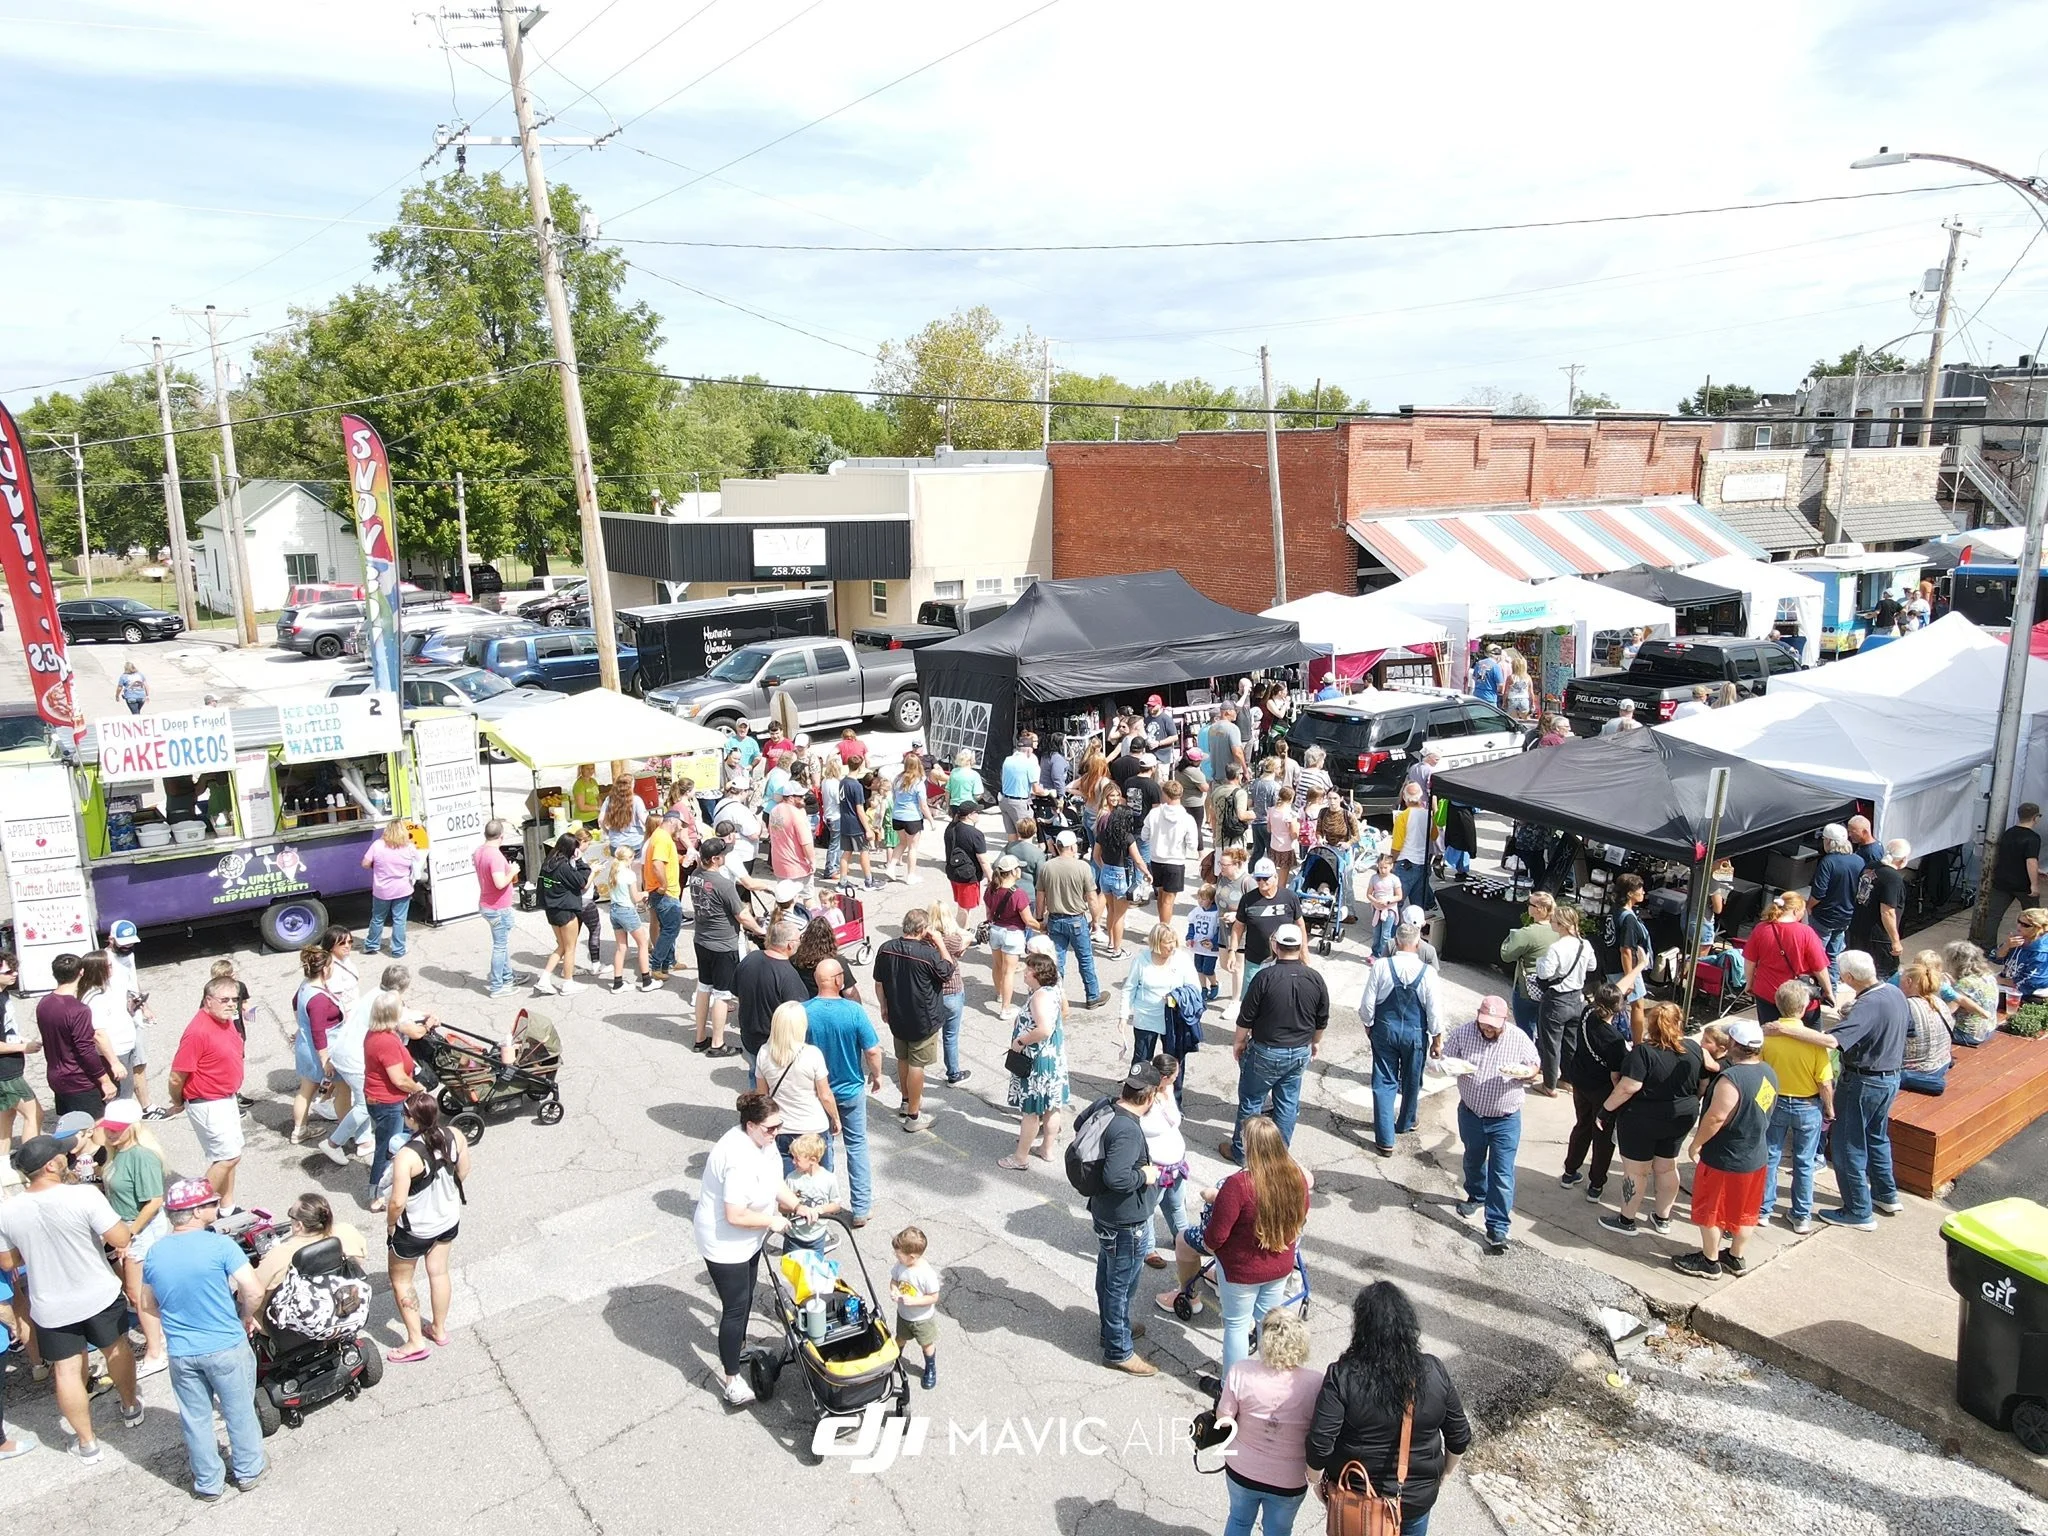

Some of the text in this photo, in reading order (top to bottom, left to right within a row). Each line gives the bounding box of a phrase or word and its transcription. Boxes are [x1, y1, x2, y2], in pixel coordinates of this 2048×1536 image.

[772, 567, 811, 576] 258.7653
[369, 698, 382, 716] 2
[1575, 694, 1603, 704] POLICE
[306, 702, 339, 717] COLD
[102, 718, 162, 741] FUNNEL
[162, 716, 189, 733] Deep
[168, 734, 229, 768] OREOS
[287, 735, 344, 756] WATER
[103, 740, 167, 775] CAKE
[7, 822, 36, 838] APPLE
[447, 812, 480, 832] OREOS
[435, 858, 469, 875] Cinnamon
[248, 872, 283, 885] UNCLE
[213, 893, 239, 904] DEEP
[1195, 920, 1210, 936] 23
[1982, 1278, 2017, 1310] GFL
